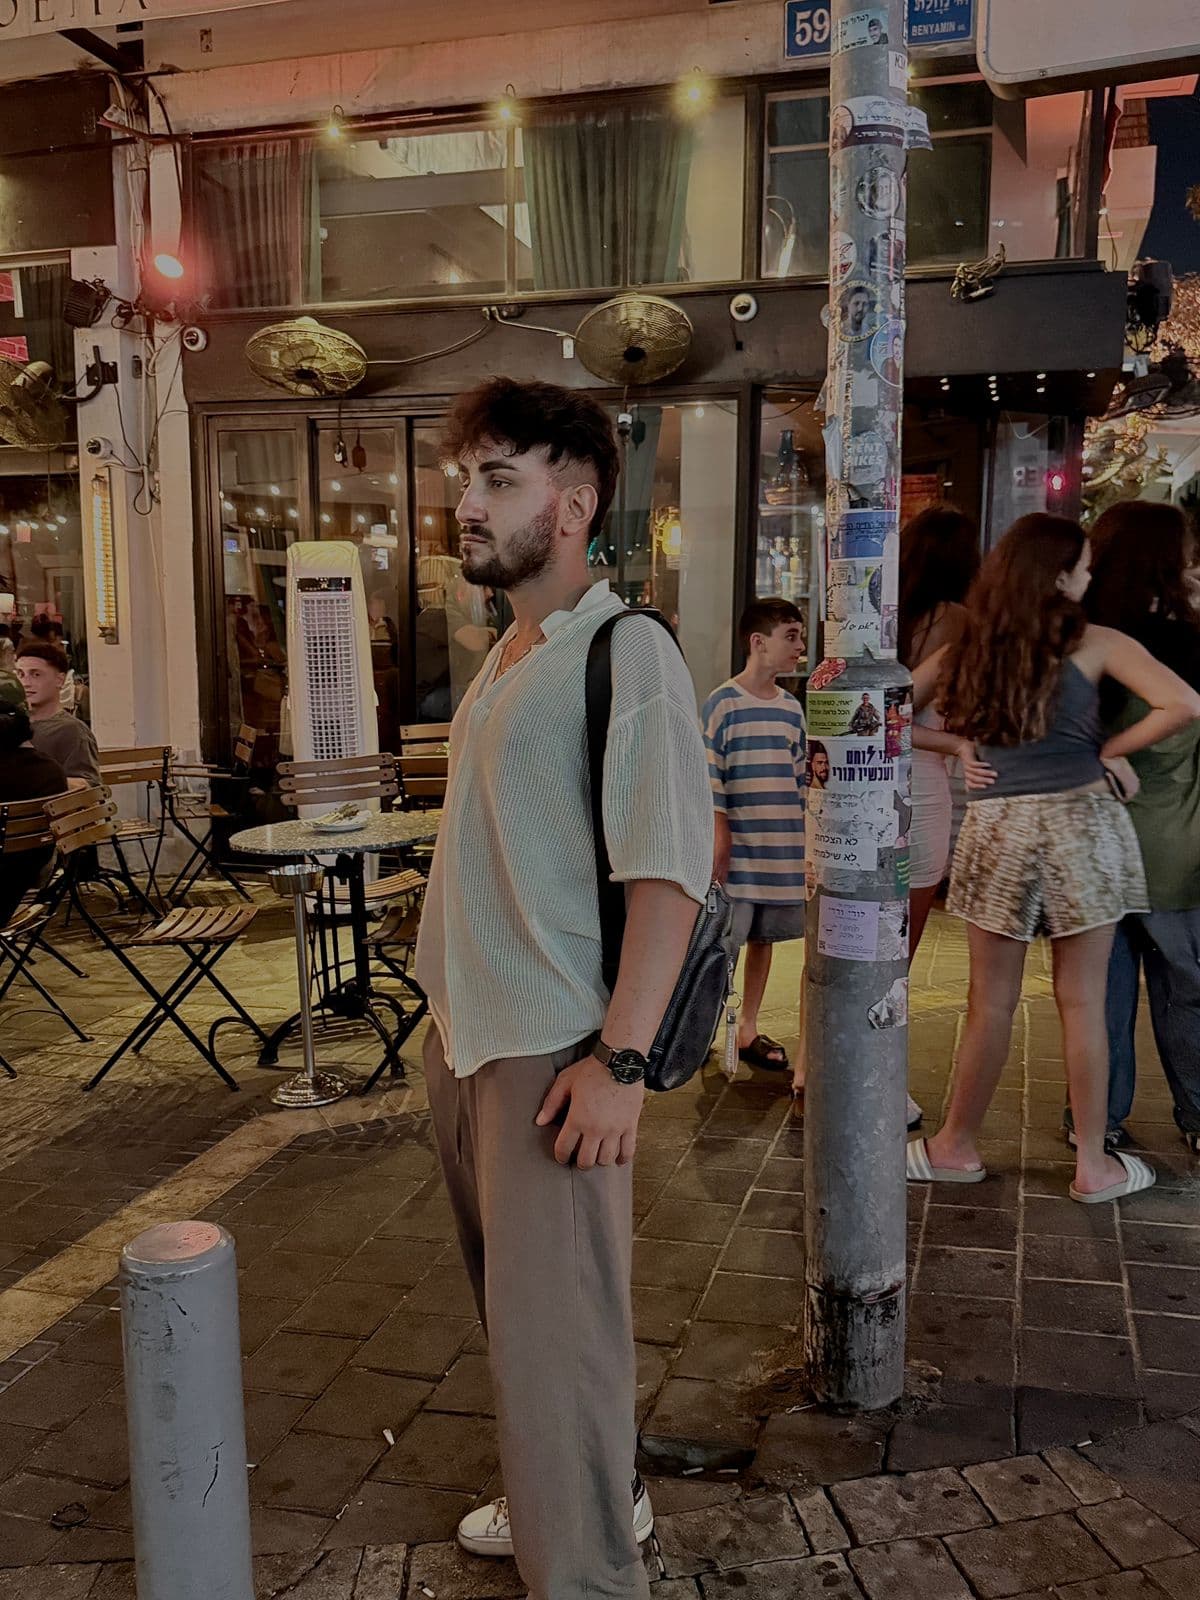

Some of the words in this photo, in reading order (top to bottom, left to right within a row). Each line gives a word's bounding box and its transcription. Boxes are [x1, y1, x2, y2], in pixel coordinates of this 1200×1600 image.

[795, 8, 830, 47] 59
[911, 21, 956, 36] BENYAMIN
[846, 745, 877, 767] לוחם
[832, 767, 855, 782] תורי
[858, 767, 894, 781] ועכשיו
[845, 834, 858, 846] לא
[843, 852, 857, 862] לא
